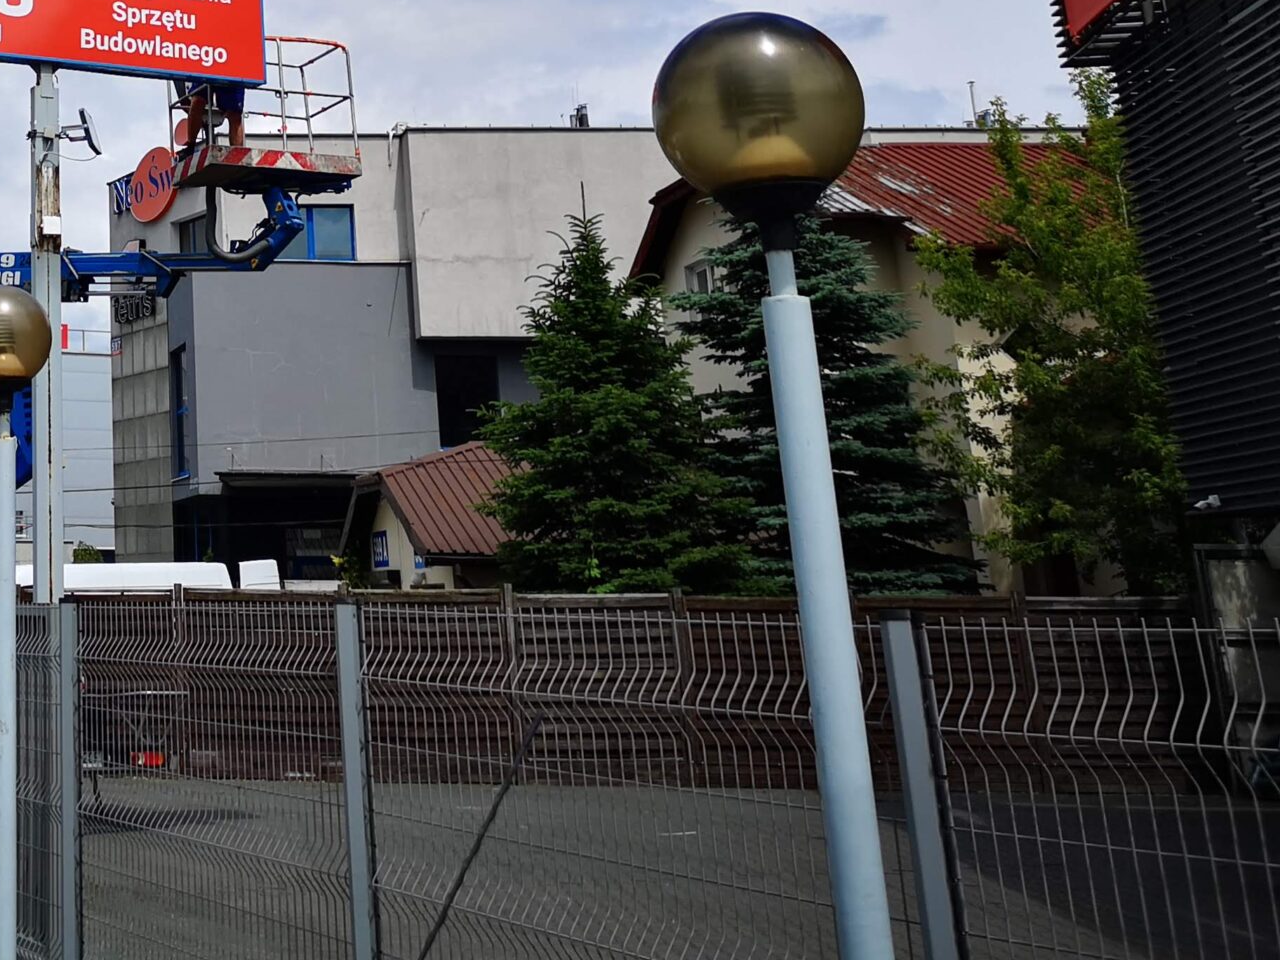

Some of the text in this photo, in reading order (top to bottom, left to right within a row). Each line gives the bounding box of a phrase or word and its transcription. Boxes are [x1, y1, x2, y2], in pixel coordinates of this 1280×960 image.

[112, 1, 196, 31] Sprzętu
[80, 27, 228, 67] Budowlanego
[112, 177, 144, 214] Neo
